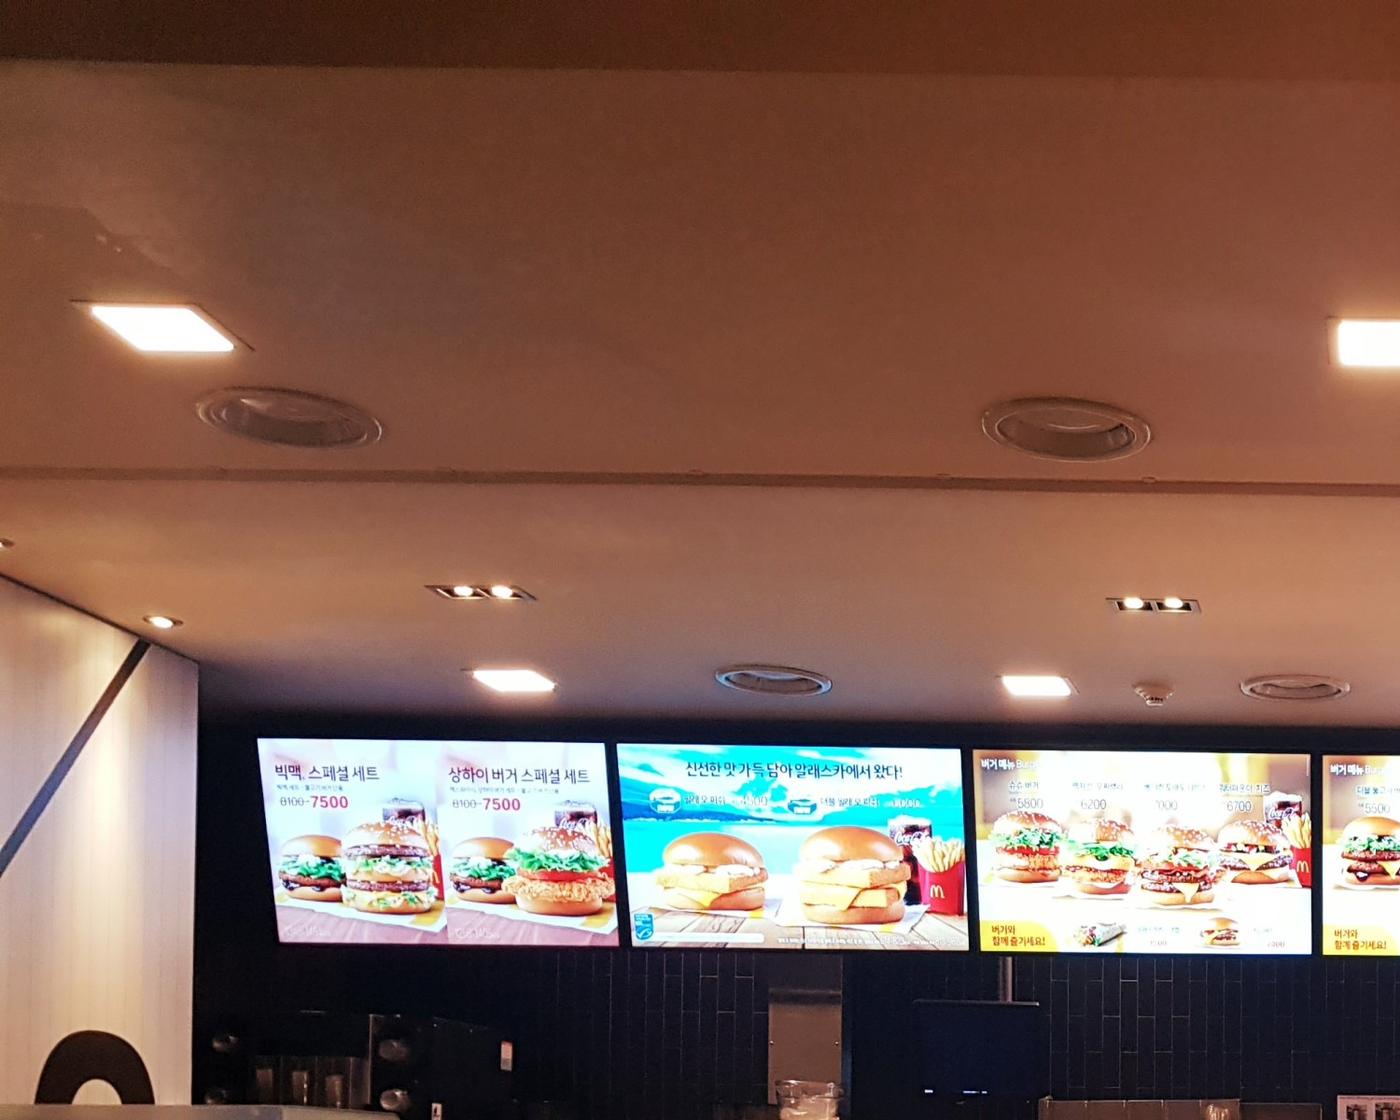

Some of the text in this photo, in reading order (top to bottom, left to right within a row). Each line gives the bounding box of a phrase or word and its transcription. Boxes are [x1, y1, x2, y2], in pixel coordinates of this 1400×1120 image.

[308, 766, 349, 781] 스페셜
[352, 766, 380, 781] 세트
[448, 767, 590, 785] 상하이 버거 스페셜 세트
[686, 762, 903, 780] 신선한 맛 가득 담아 알래스카에서 왔다!
[310, 795, 349, 809] 7500
[483, 797, 521, 811] 7500
[1226, 800, 1252, 812] 6700
